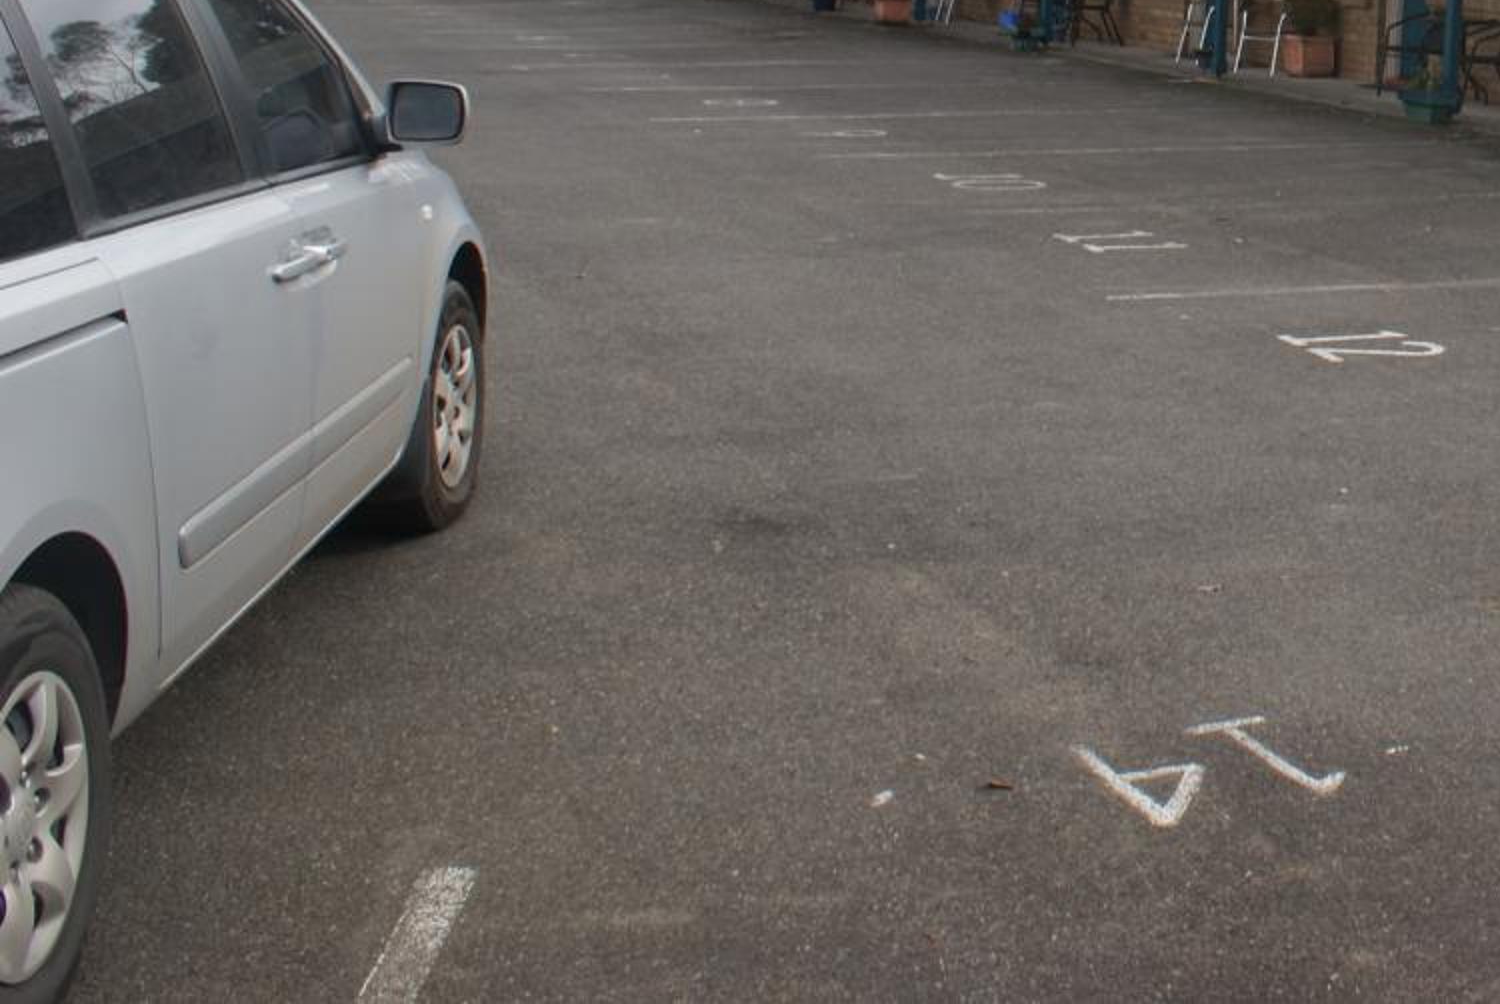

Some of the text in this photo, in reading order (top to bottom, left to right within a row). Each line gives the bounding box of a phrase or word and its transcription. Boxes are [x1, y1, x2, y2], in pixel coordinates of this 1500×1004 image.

[932, 172, 1047, 191] 10
[1052, 229, 1188, 253] 11
[1276, 329, 1446, 363] 12
[1071, 715, 1346, 828] 14
